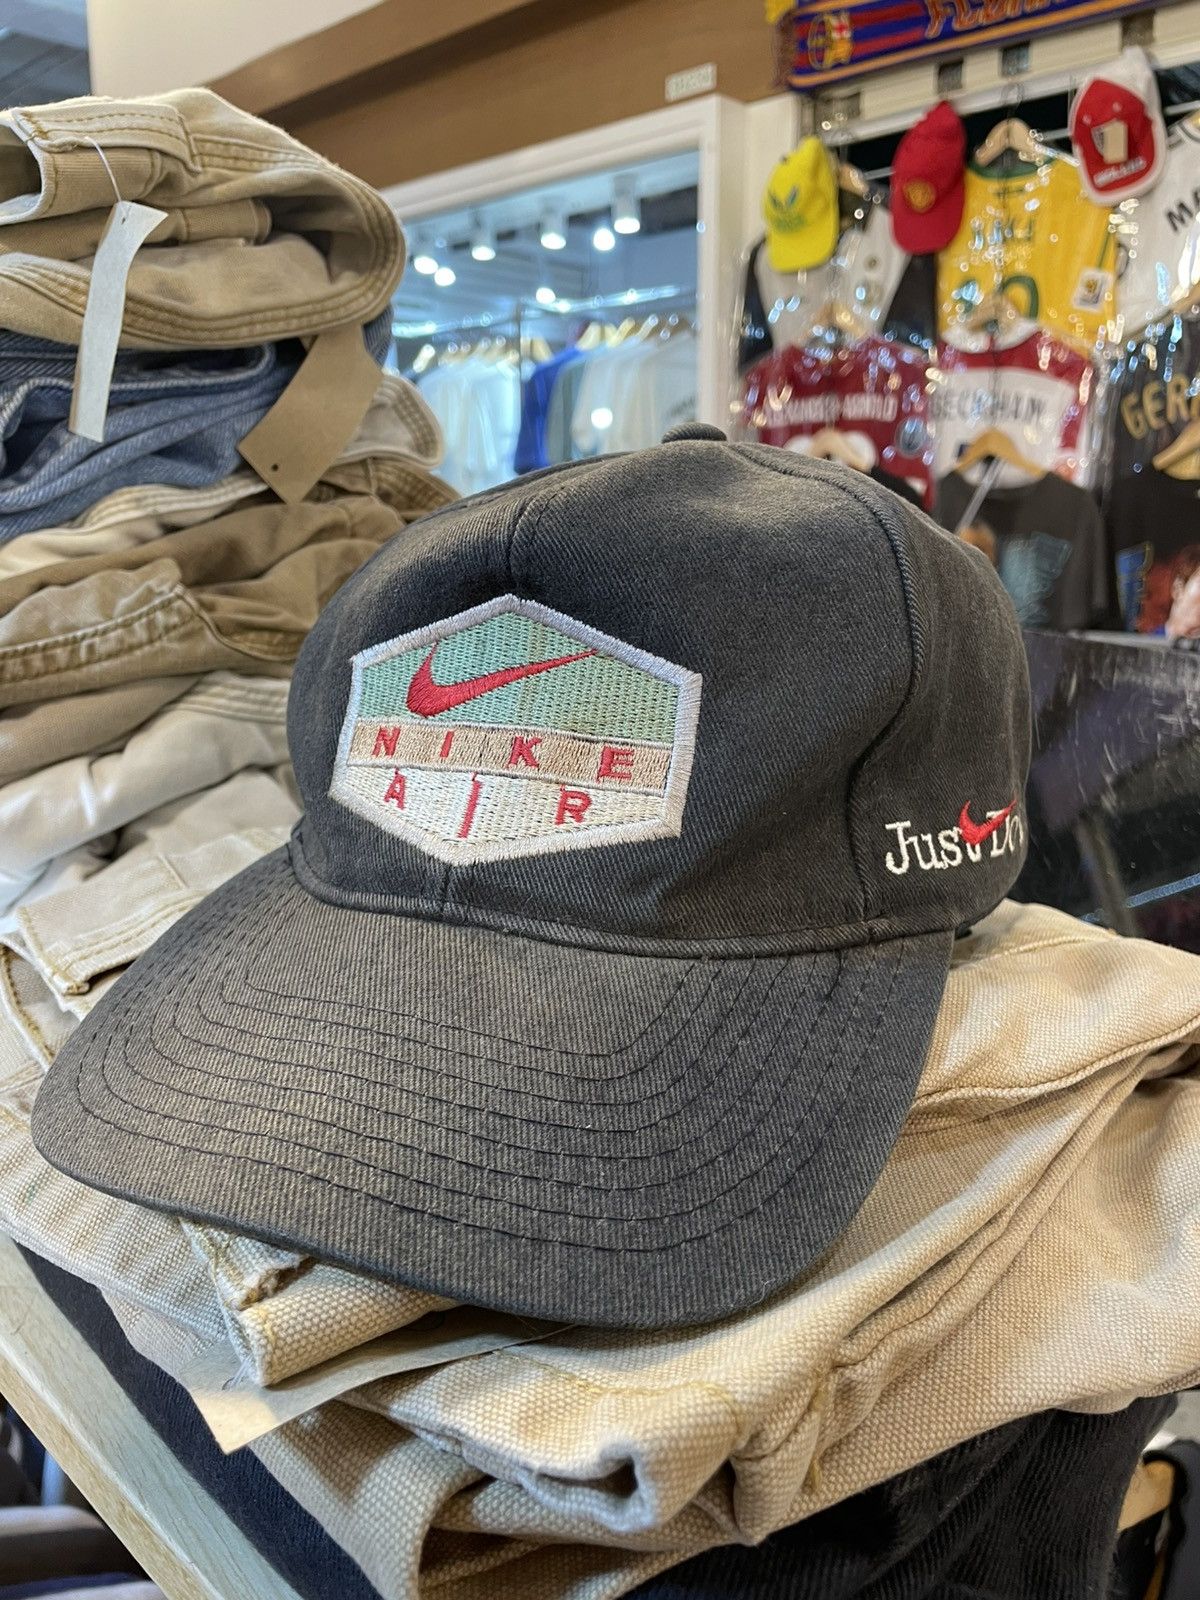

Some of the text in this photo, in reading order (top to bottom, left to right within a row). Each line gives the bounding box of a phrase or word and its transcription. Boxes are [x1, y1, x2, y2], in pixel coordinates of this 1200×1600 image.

[926, 387, 1047, 424] BECHAM
[371, 726, 636, 782] NIKE
[383, 768, 594, 839] AIR
